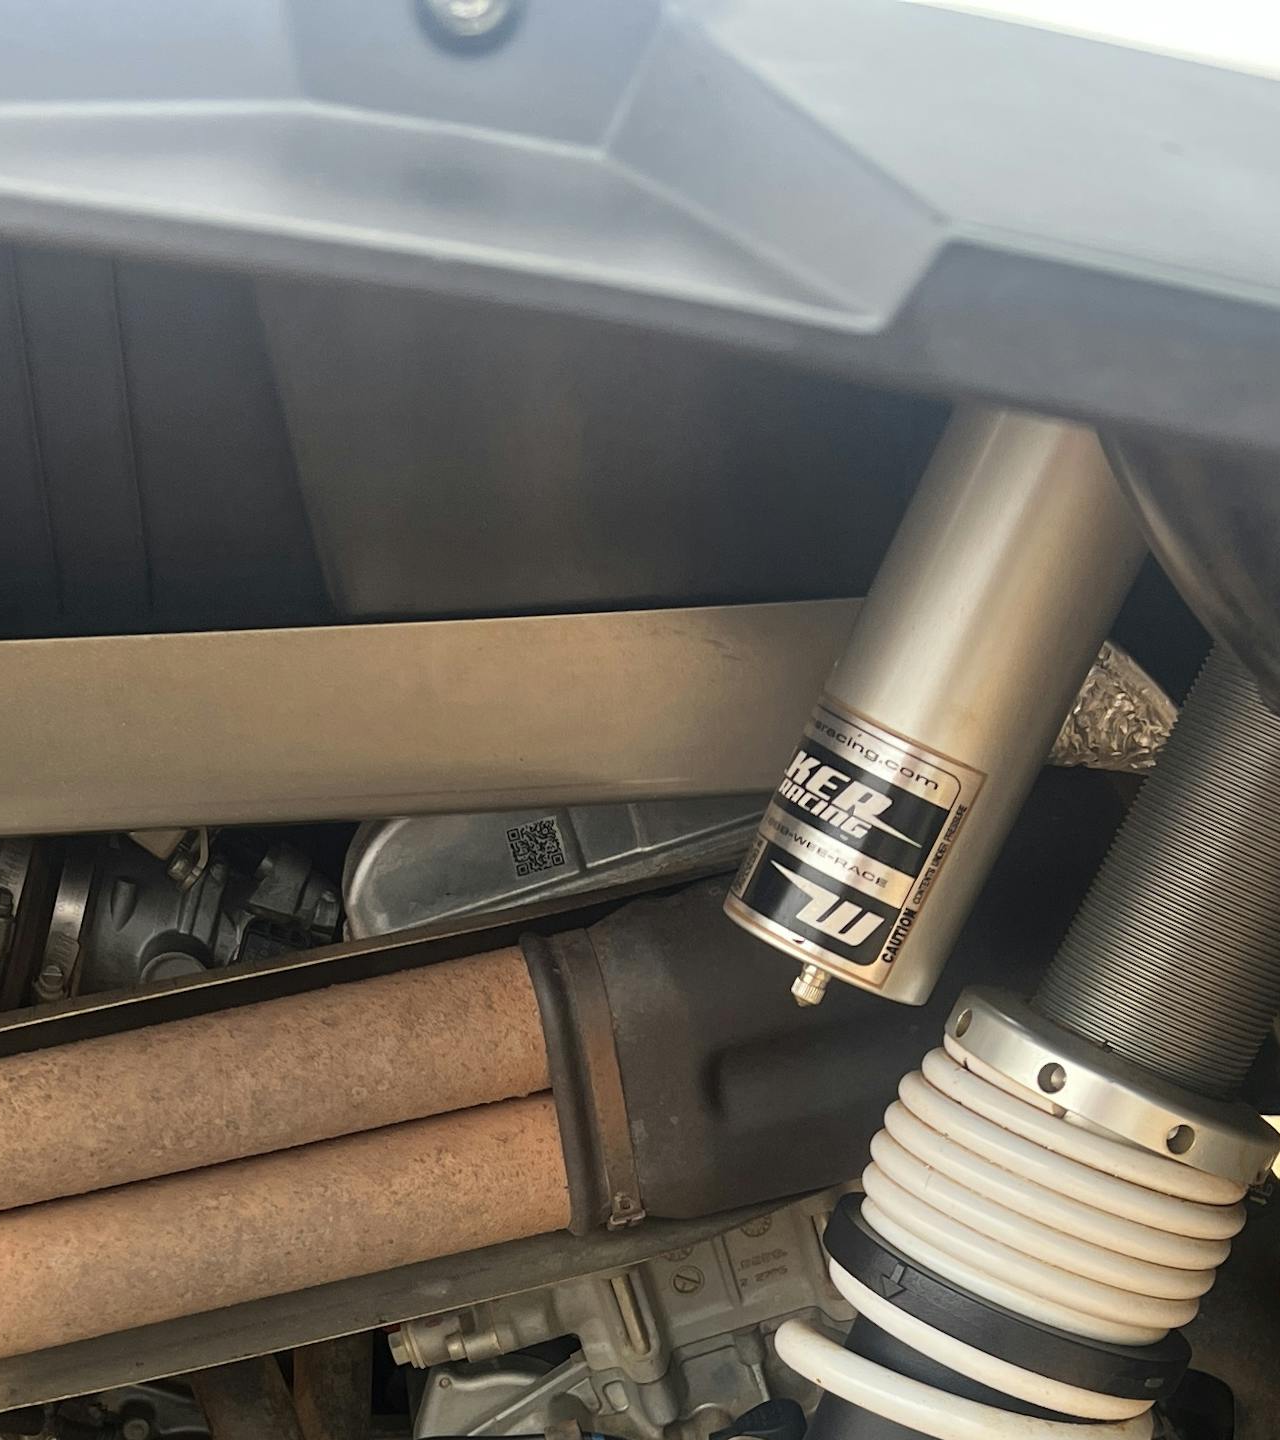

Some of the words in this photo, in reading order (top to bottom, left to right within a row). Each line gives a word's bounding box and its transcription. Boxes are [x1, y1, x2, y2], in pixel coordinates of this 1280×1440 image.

[778, 777, 872, 839] RACING
[881, 907, 917, 963] CAUTION
[913, 867, 935, 904] CONTENTS
[931, 842, 947, 867] UNDER
[943, 804, 967, 842] PRESSURE
